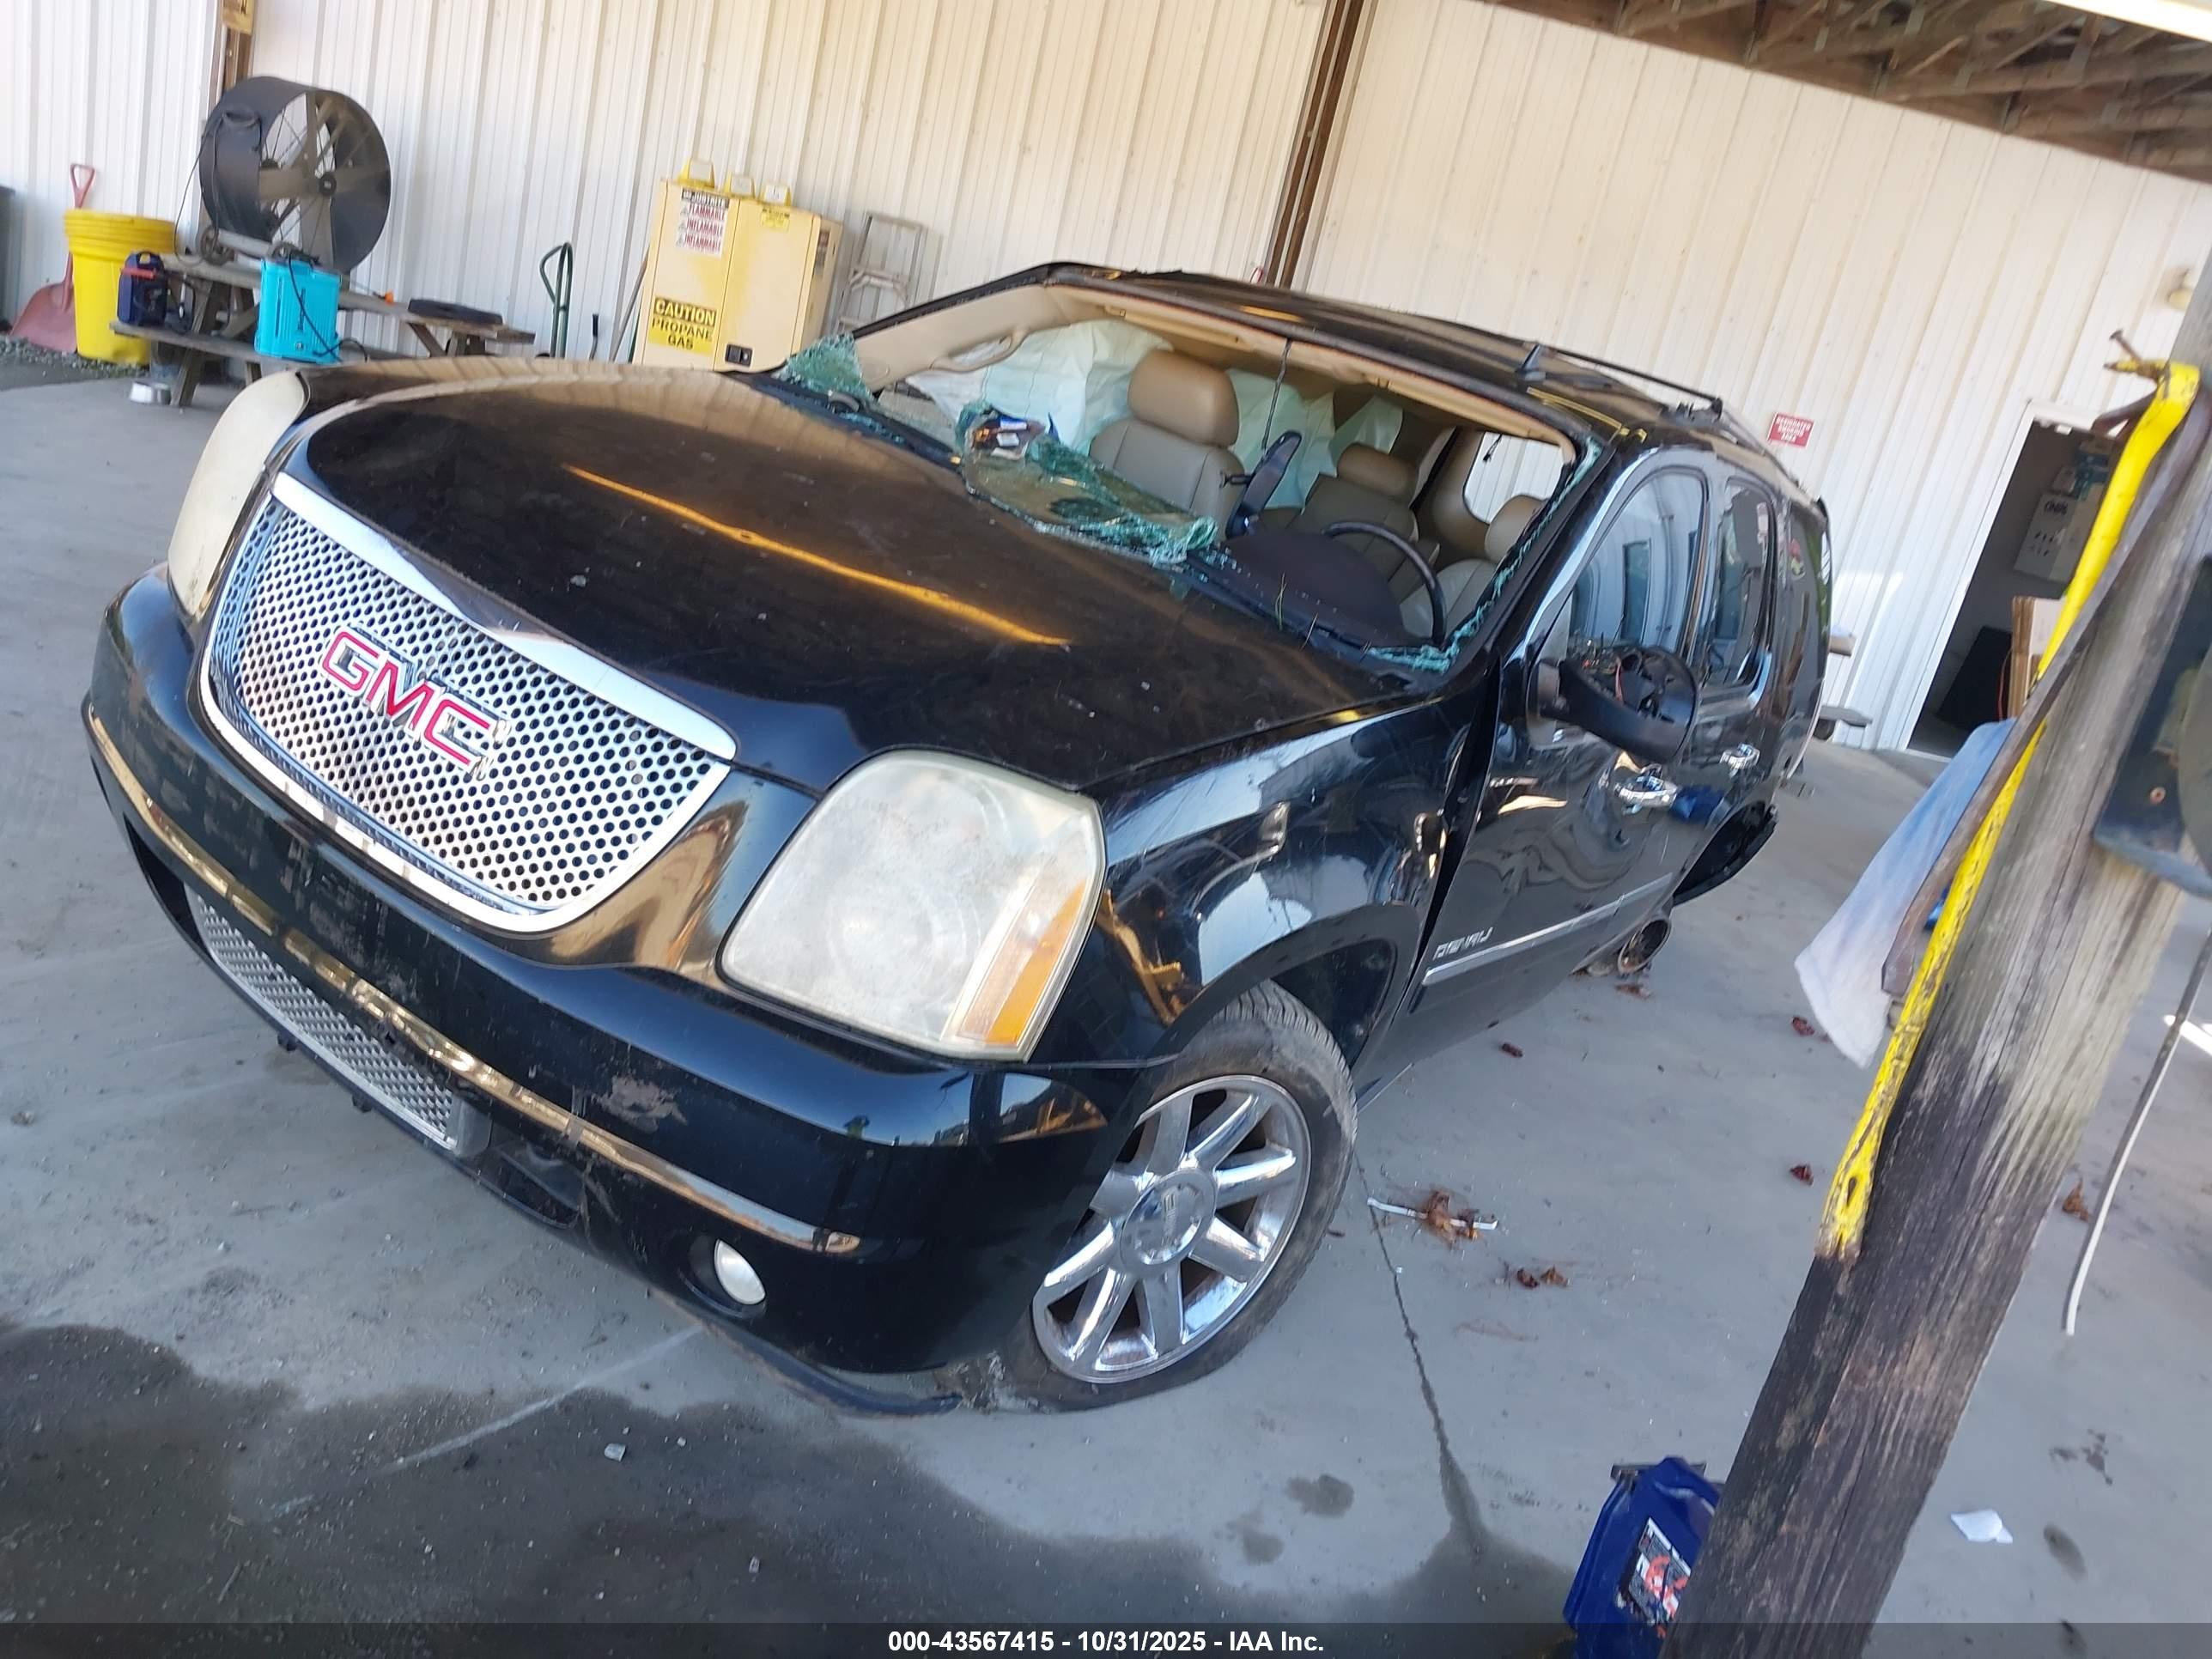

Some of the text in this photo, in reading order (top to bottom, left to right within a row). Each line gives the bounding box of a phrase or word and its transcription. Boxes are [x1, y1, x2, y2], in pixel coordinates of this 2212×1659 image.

[655, 299, 715, 326] CAUTION
[652, 317, 712, 343] PROPANE
[668, 334, 694, 349] GAS
[319, 626, 501, 773] GMC
